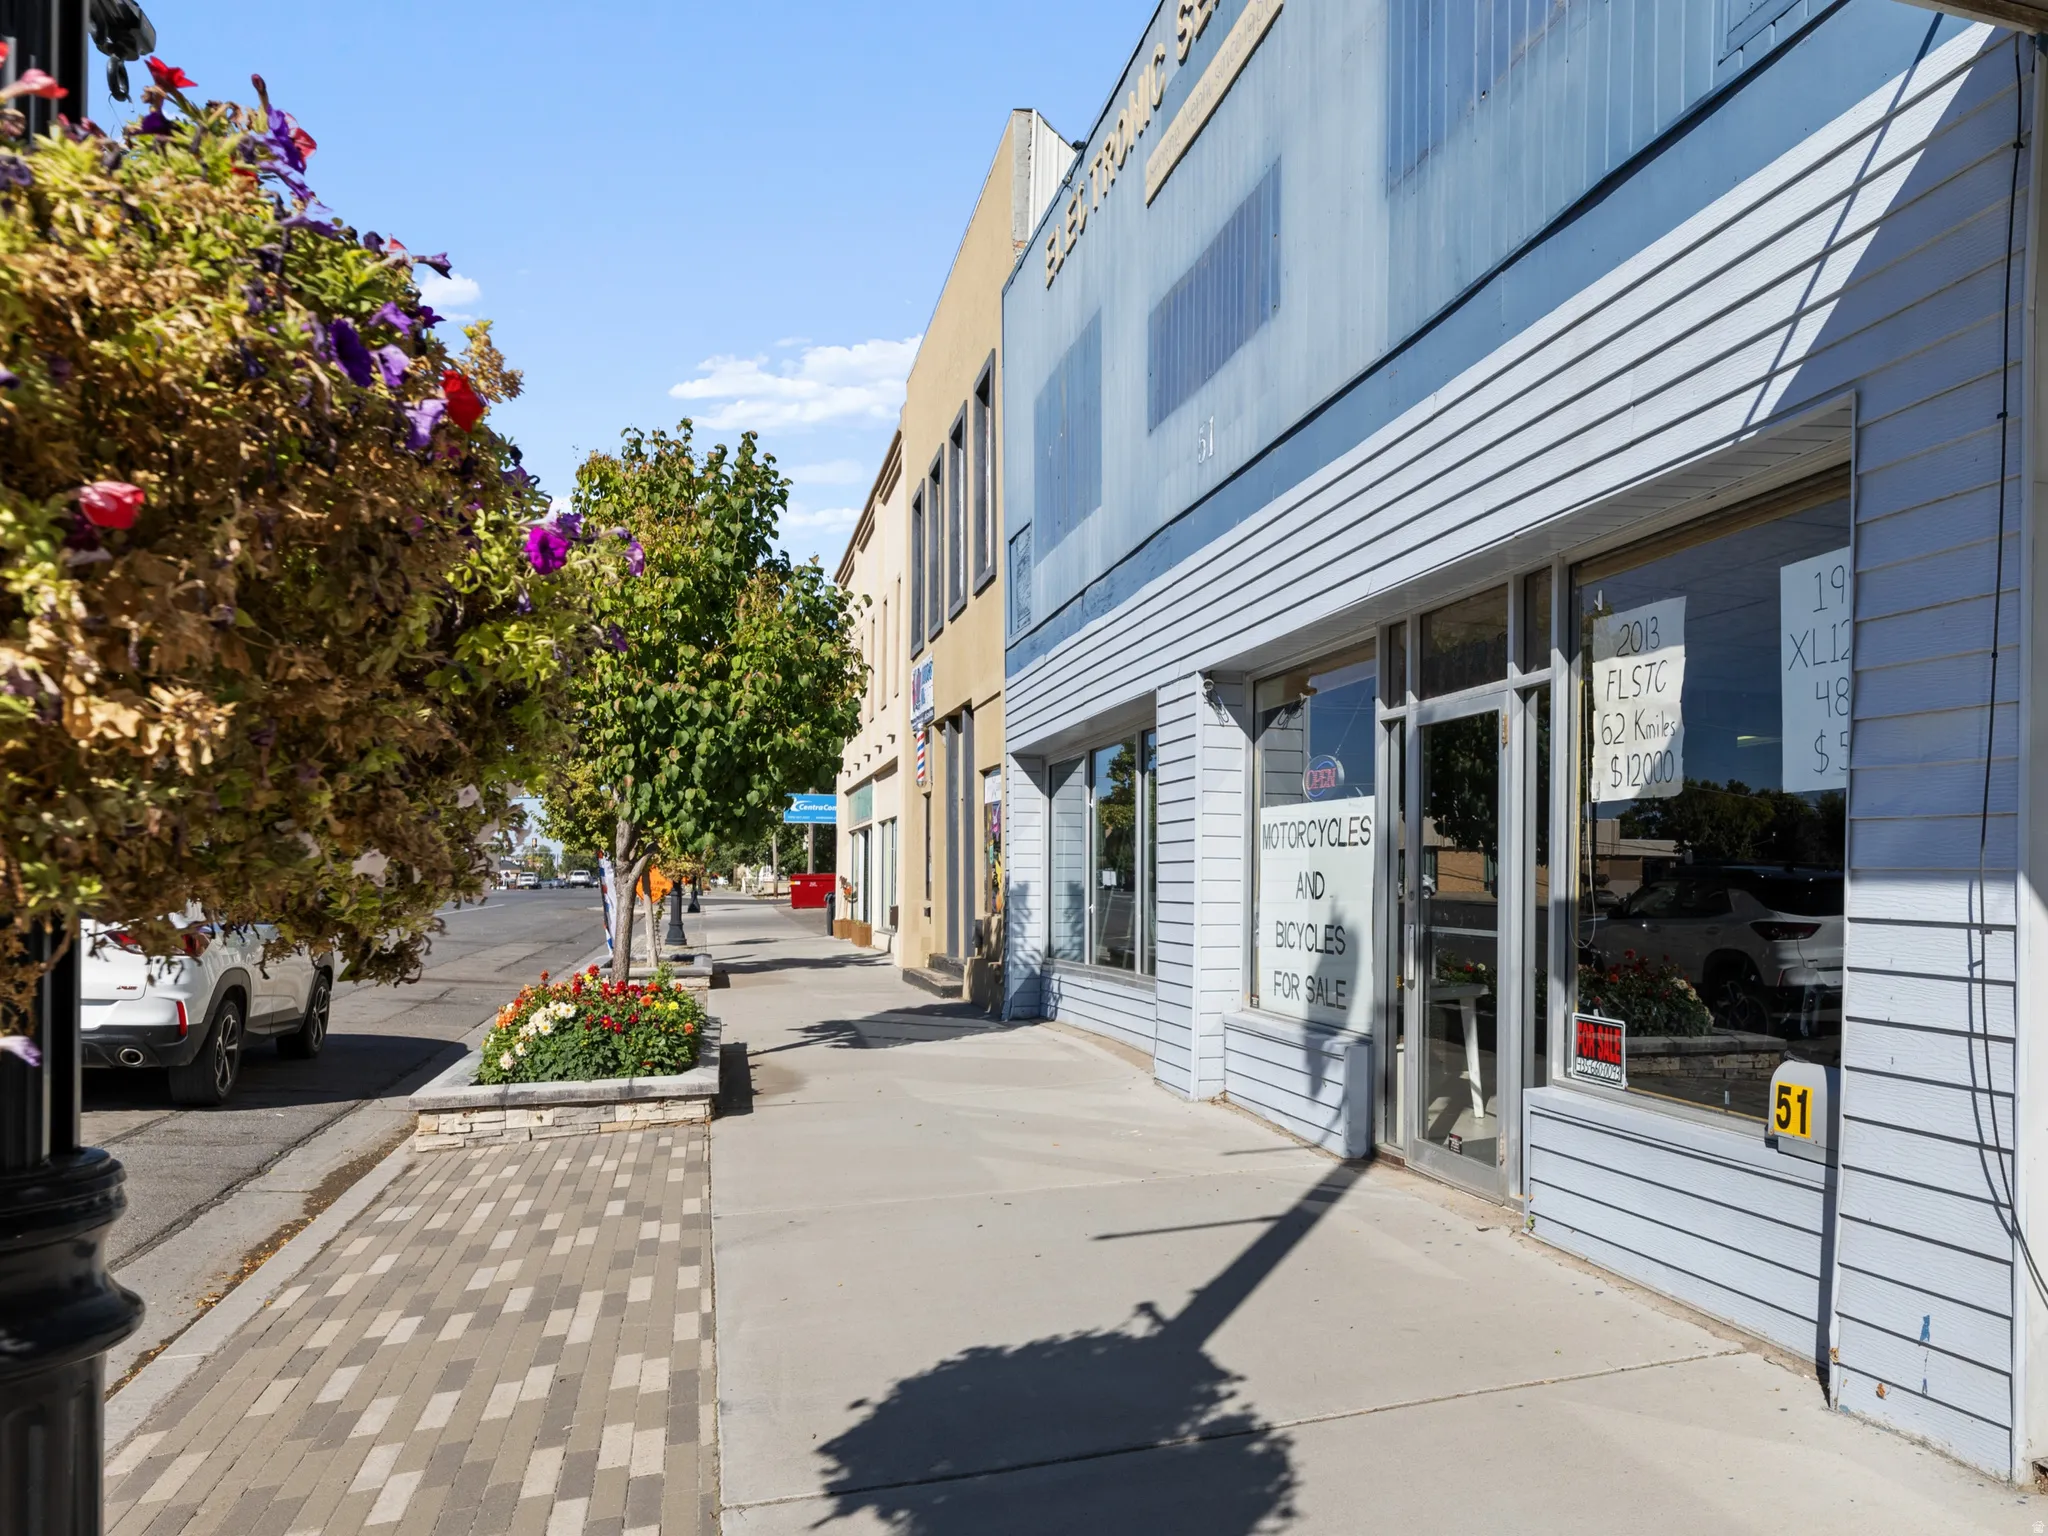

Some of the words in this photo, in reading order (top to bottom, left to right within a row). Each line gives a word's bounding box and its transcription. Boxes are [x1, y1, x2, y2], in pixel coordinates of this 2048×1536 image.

[1045, 43, 1166, 290] ELECTRONIC
[1177, 0, 1220, 66] SE
[1198, 415, 1214, 463] 51
[1813, 564, 1850, 613] 19
[1616, 616, 1660, 657] 2013
[1788, 618, 1850, 671] XL12
[1606, 659, 1668, 702] FLSTC
[1815, 676, 1849, 718] 48
[1601, 713, 1625, 746] 62
[1305, 767, 1338, 791] OPEN
[1262, 815, 1372, 850] MOTORCYCLES
[1295, 871, 1325, 900] AND
[1275, 920, 1346, 956] BICYCLES
[1273, 970, 1300, 1001] FOR
[1305, 975, 1347, 1010] SALE
[1576, 1021, 1595, 1058] FOR
[1597, 1025, 1622, 1065] SALE
[1775, 1084, 1808, 1135] 51
